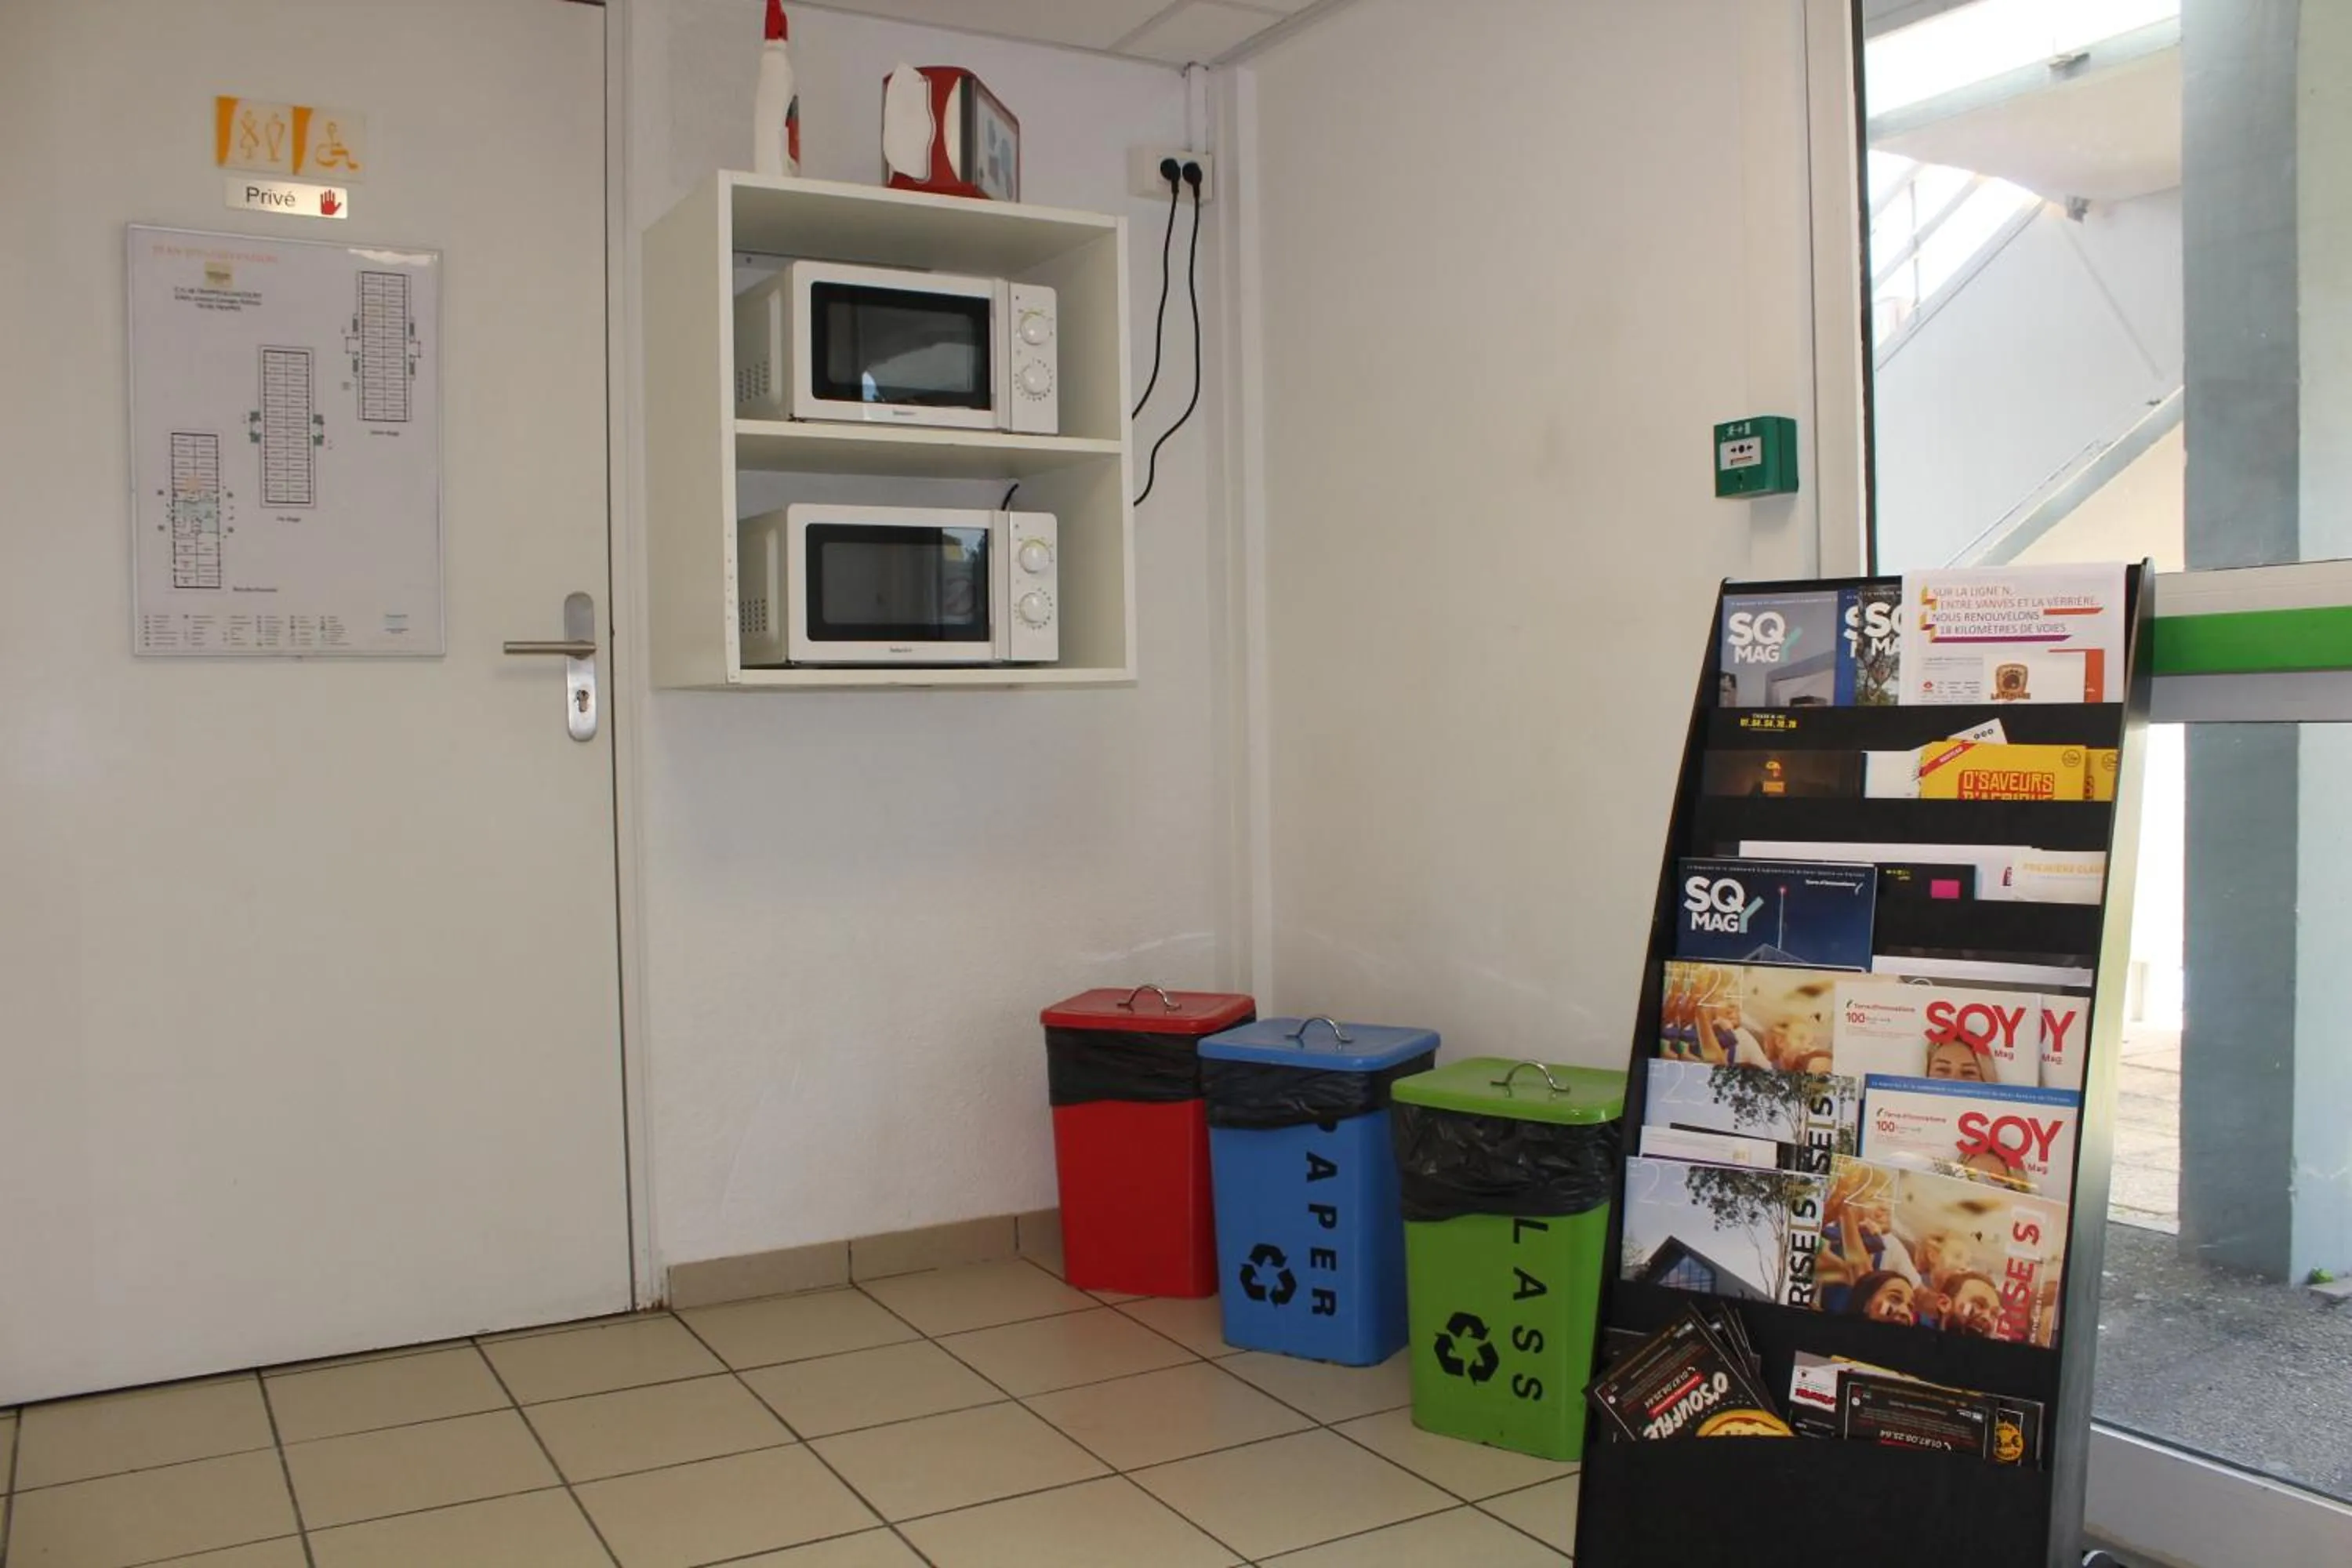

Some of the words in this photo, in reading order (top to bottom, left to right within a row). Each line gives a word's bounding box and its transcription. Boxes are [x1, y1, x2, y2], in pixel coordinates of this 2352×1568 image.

[245, 186, 296, 207] Privé
[1956, 587, 1968, 597] LA
[1940, 599, 1973, 610] ENTRE
[1975, 597, 2016, 609] VANVES
[2017, 597, 2028, 608] ET
[2031, 597, 2045, 607] LA
[1932, 612, 1961, 622] NOUS
[1964, 610, 2040, 622] RENOUVELONS
[2020, 623, 2033, 634] DE
[1994, 1049, 2015, 1062] Mag
[2042, 1053, 2063, 1065] Mag
[1875, 1120, 1896, 1133] 100
[2027, 1163, 2048, 1174] Mag
[1305, 1121, 1338, 1317] APER
